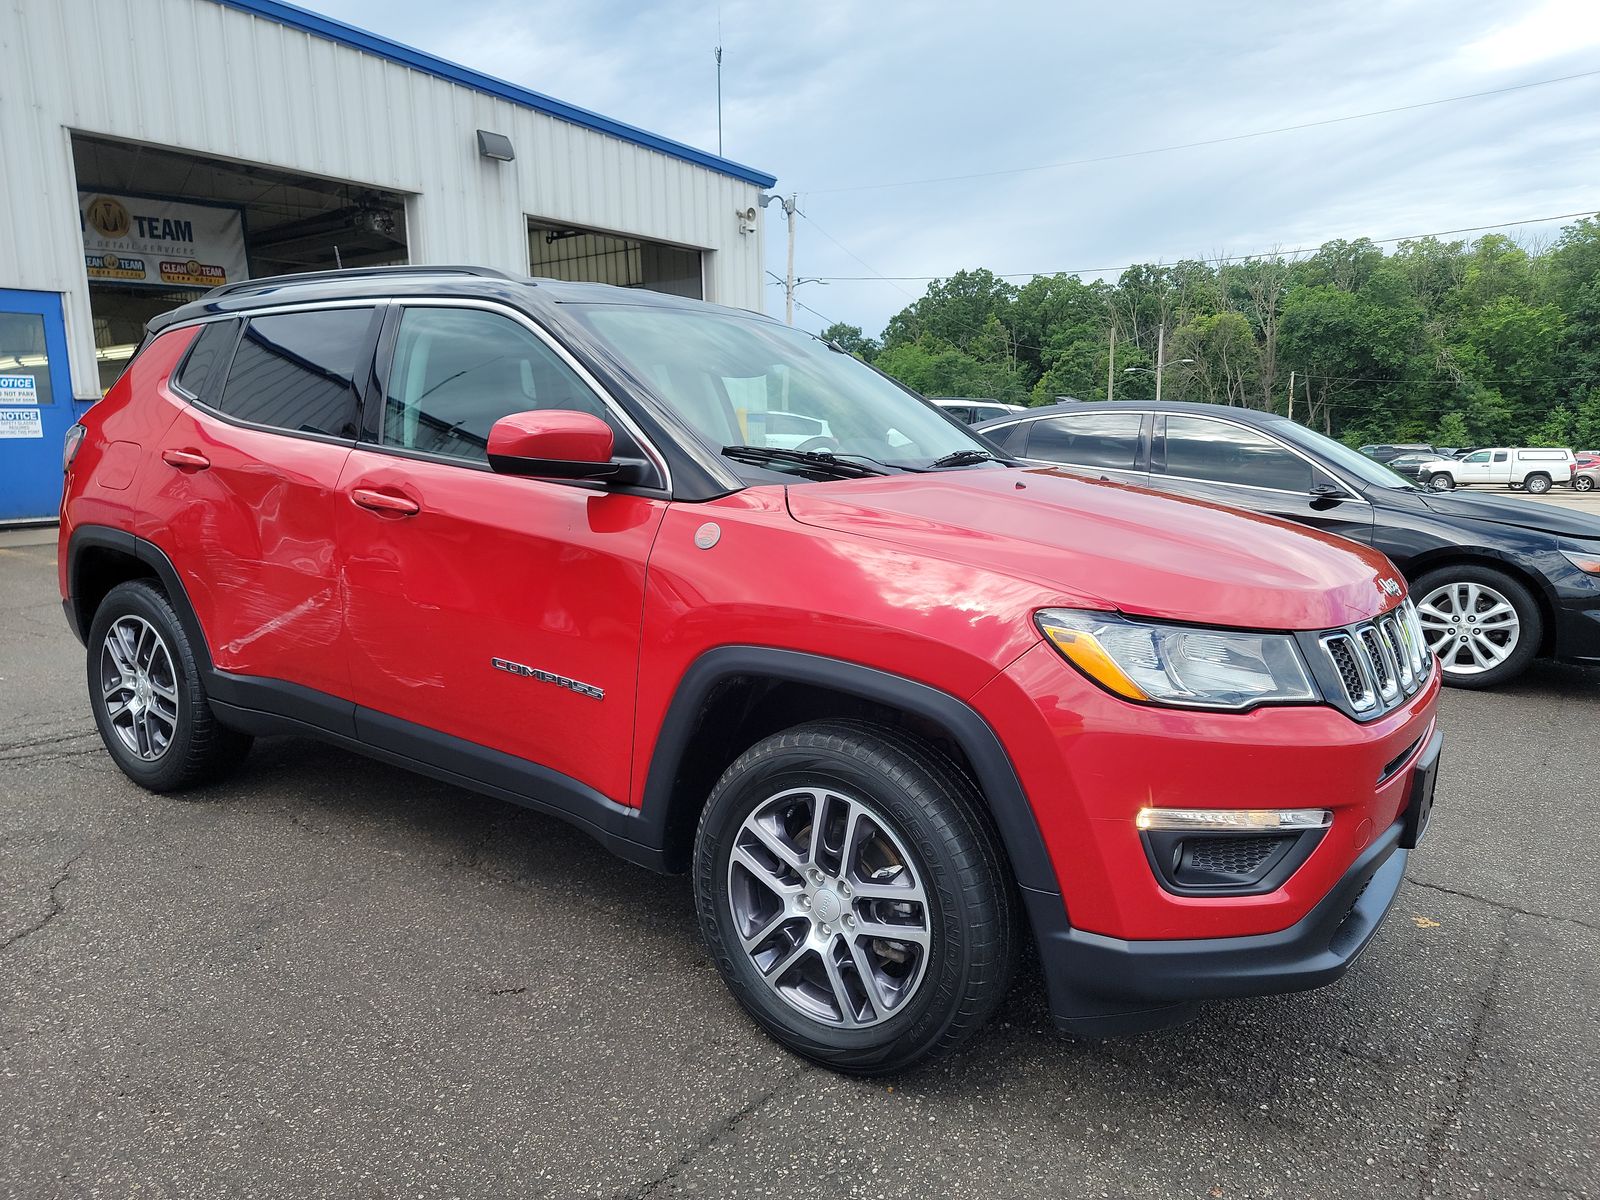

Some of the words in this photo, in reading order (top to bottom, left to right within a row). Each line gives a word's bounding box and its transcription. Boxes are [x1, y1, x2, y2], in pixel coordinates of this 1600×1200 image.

[133, 216, 193, 242] TEAM
[97, 240, 136, 250] DETAIL
[143, 243, 195, 255] SERVICES
[86, 257, 103, 267] EAN
[120, 260, 142, 270] TEAM
[162, 264, 187, 273] CLEAN
[201, 267, 222, 276] TEAM
[1, 378, 31, 387] OTICE
[0, 411, 37, 420] NOTICE
[491, 656, 604, 700] COMPASS
